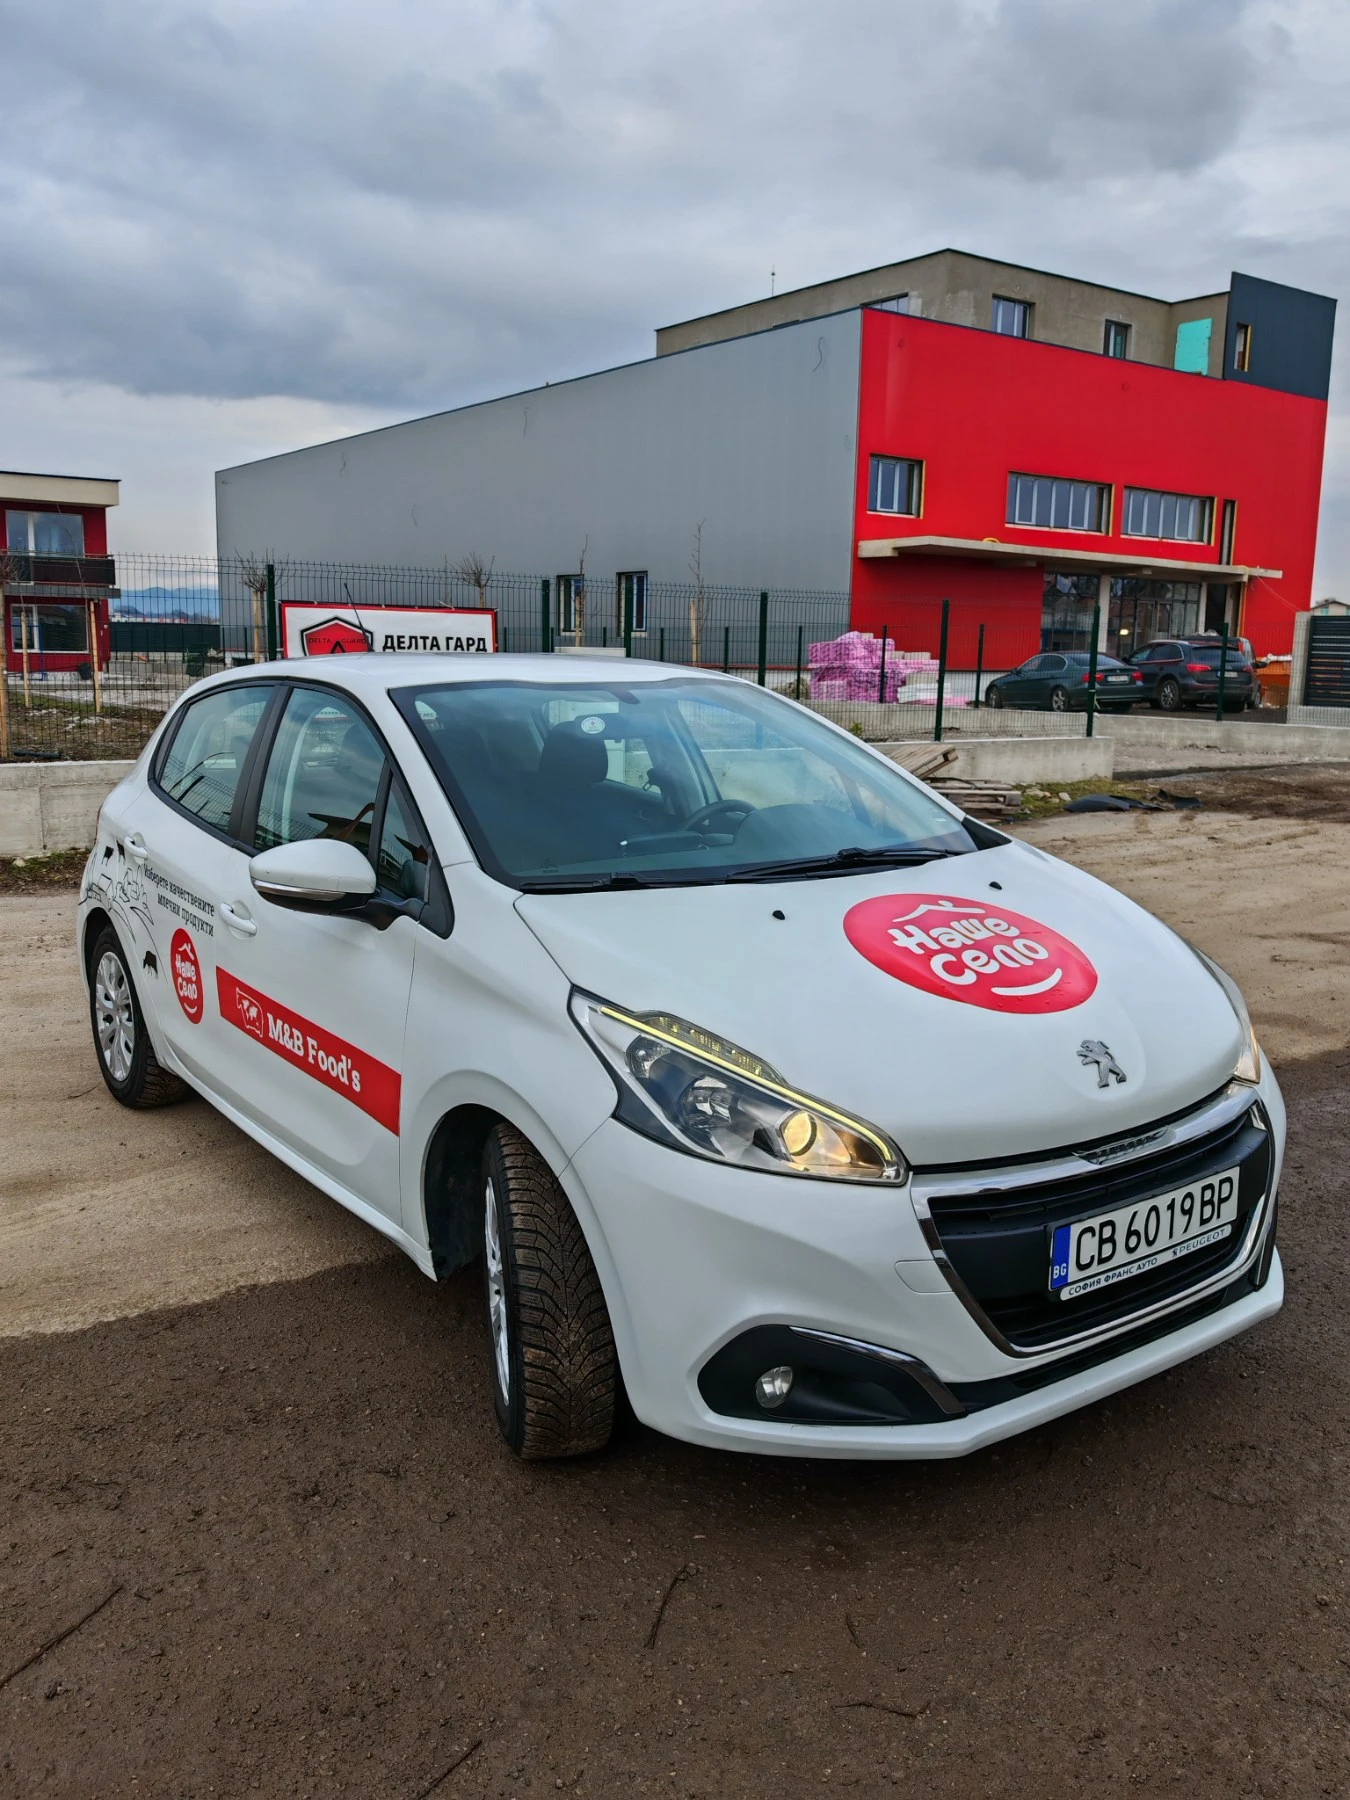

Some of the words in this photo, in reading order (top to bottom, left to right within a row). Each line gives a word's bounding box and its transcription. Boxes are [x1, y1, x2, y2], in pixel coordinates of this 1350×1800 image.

[382, 634, 442, 652] ДЕЛТА
[445, 636, 488, 653] ГАРД
[181, 907, 214, 937] продукти
[266, 1012, 305, 1057] M&B
[306, 1035, 361, 1093] Food's
[1178, 1228, 1226, 1254] PEUGEOT
[1053, 1263, 1067, 1279] BG
[1068, 1278, 1101, 1296] СОФИЯ
[1103, 1265, 1135, 1283] ФРАНС
[1135, 1257, 1158, 1272] АУТО
